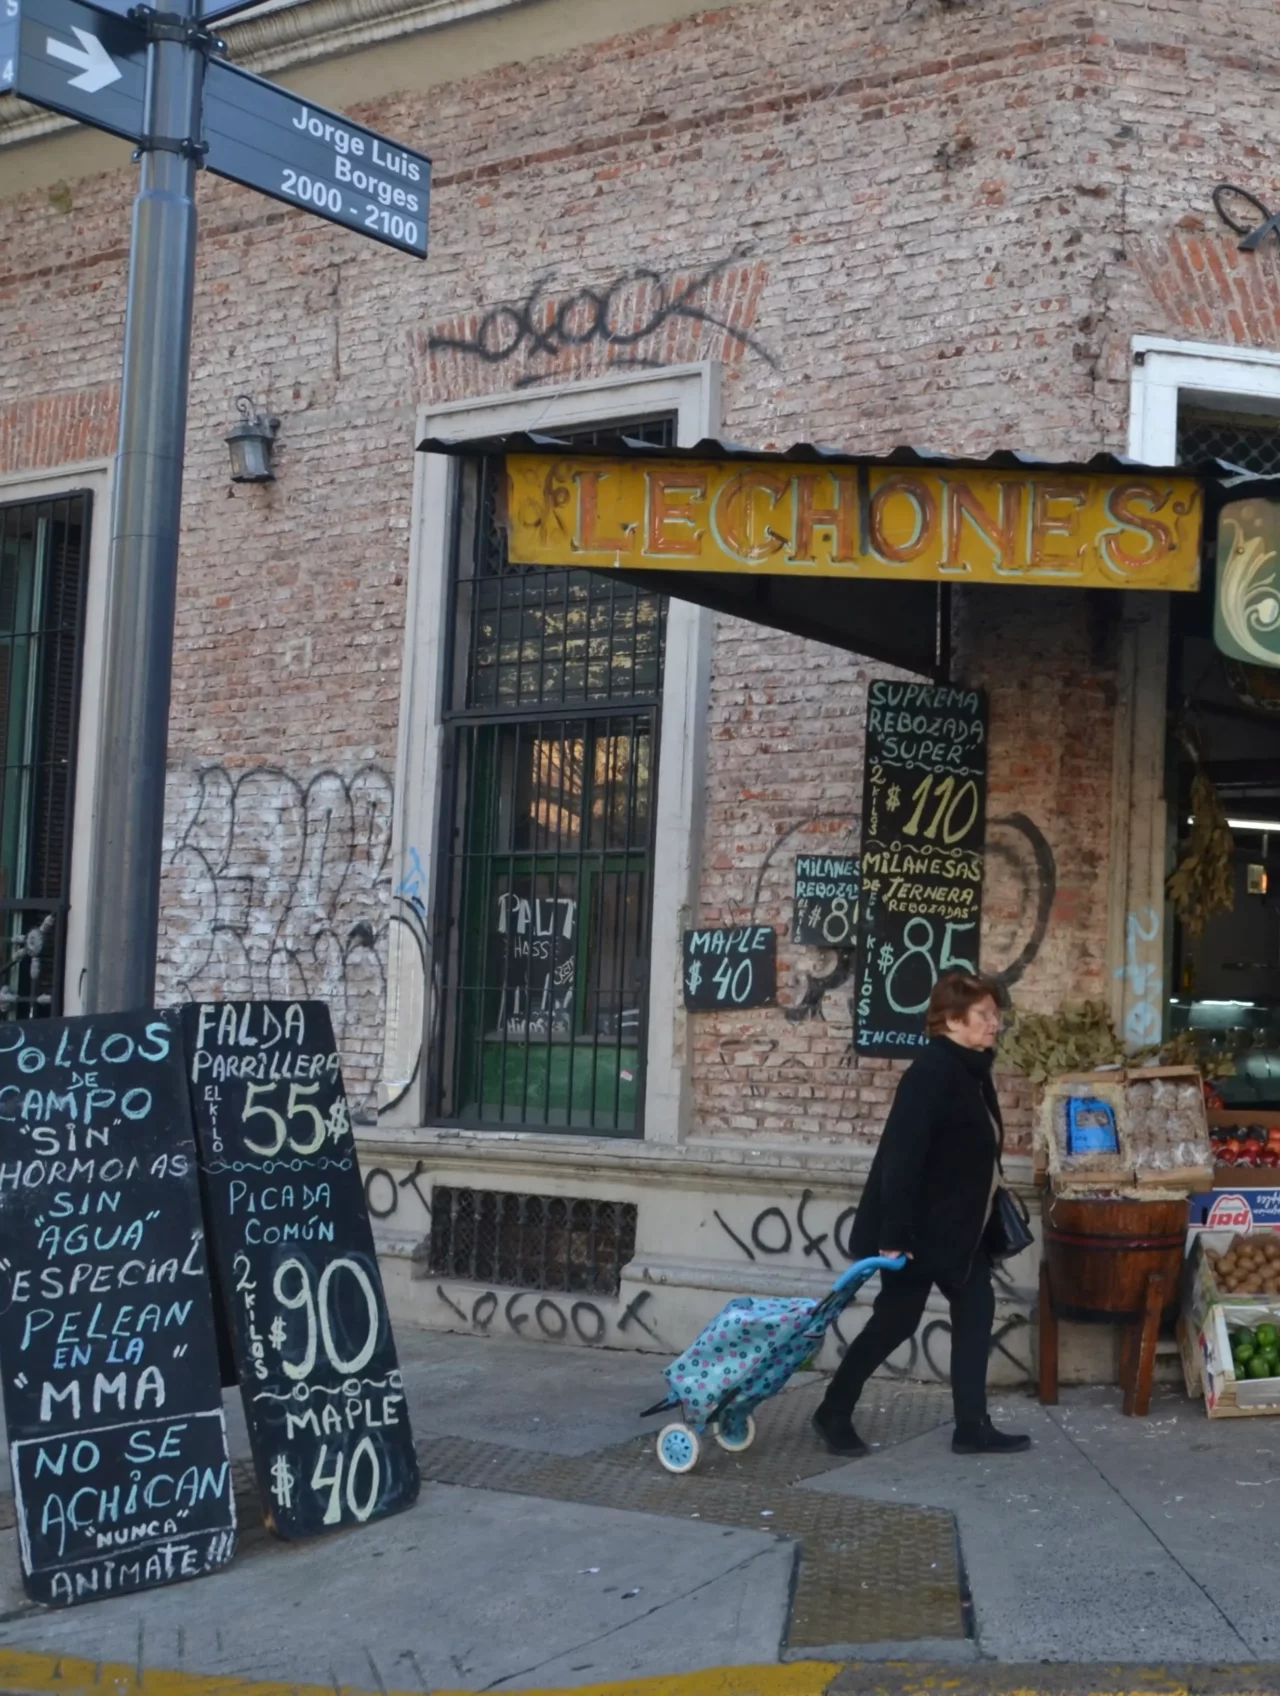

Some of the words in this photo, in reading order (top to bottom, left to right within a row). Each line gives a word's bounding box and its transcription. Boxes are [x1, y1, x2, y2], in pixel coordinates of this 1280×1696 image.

[292, 106, 365, 156] Jorge
[372, 139, 420, 181] Luis
[335, 155, 419, 212] Borges
[281, 168, 342, 213] 2000
[364, 204, 418, 245] 2100
[572, 466, 1182, 577] LECHONES
[868, 681, 979, 715] SUPREMA
[868, 707, 984, 744] REBOZADA
[870, 764, 886, 785] 2
[868, 785, 881, 836] KILOS
[886, 781, 901, 812] $
[902, 773, 979, 844] 110
[862, 851, 982, 882] MILANESAS
[862, 878, 881, 893] DE
[886, 876, 975, 905] TERNERA
[689, 926, 772, 956] MAPLE
[877, 942, 895, 975] $
[685, 959, 702, 996] $
[712, 956, 753, 1003] 40
[196, 1001, 306, 1049] FALDA
[66, 1071, 99, 1090] DE
[191, 1050, 341, 1085] PARRILLERA
[0, 1085, 152, 1125] CAMPO
[204, 1085, 222, 1101] EL
[208, 1102, 224, 1152] KILO
[48, 1190, 121, 1218] SIN
[229, 1180, 332, 1215] PICADA
[245, 1215, 335, 1245] COMÚN
[1208, 1209, 1250, 1226] pai
[233, 1254, 257, 1292] 2
[20, 1299, 194, 1351] PELEAN
[243, 1292, 269, 1381] KILOS
[268, 1316, 288, 1351] $
[273, 1257, 379, 1381] 90
[53, 1344, 92, 1369] EN
[105, 1337, 145, 1364] LA
[285, 1393, 404, 1440] MAPLE
[34, 1439, 101, 1479] NO
[125, 1423, 188, 1464] SE
[270, 1454, 294, 1508] $
[311, 1436, 380, 1526] 40
[41, 1460, 229, 1557] ACHICAN
